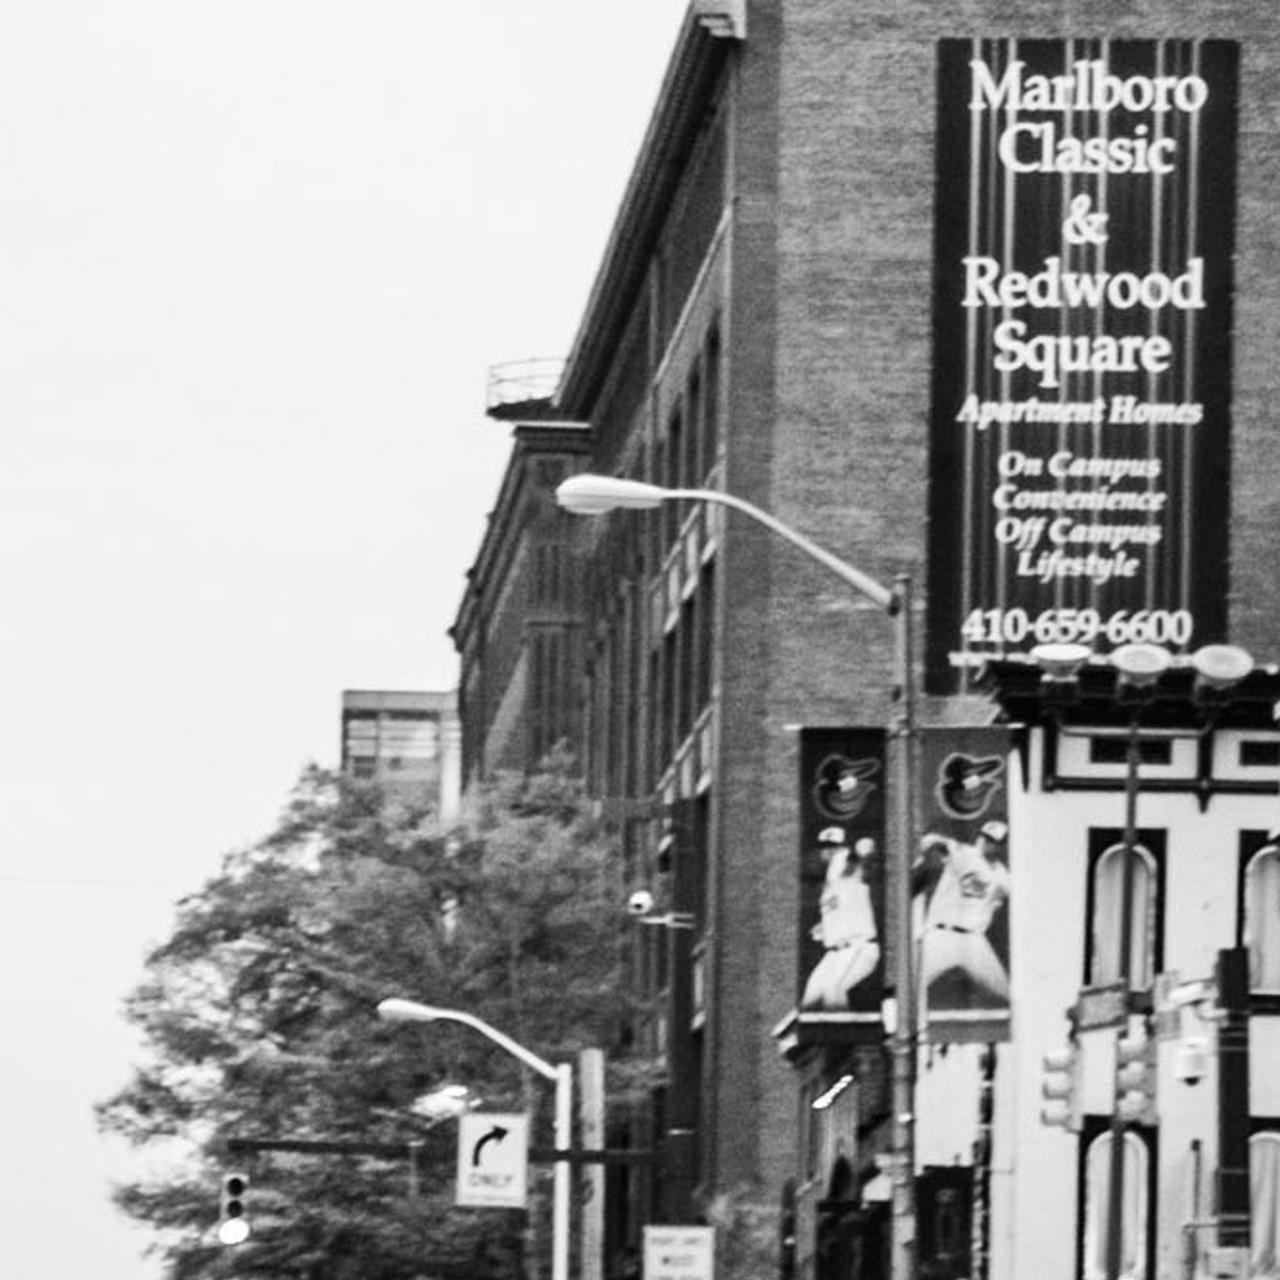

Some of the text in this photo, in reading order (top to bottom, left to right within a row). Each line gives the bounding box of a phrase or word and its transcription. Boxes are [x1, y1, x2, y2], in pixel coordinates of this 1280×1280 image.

[968, 60, 1208, 112] Marlboro
[999, 121, 1176, 174] Classic
[1062, 193, 1108, 244] &
[961, 256, 1206, 309] Redwood
[993, 320, 1172, 388] Square
[956, 393, 1203, 430] Apartment Homes
[998, 451, 1161, 484] On Campus
[993, 484, 1167, 511] Convenience
[995, 517, 1161, 549] Off Campus
[1017, 550, 1139, 585] Lifestyle
[960, 608, 1193, 645] 410-659-6600
